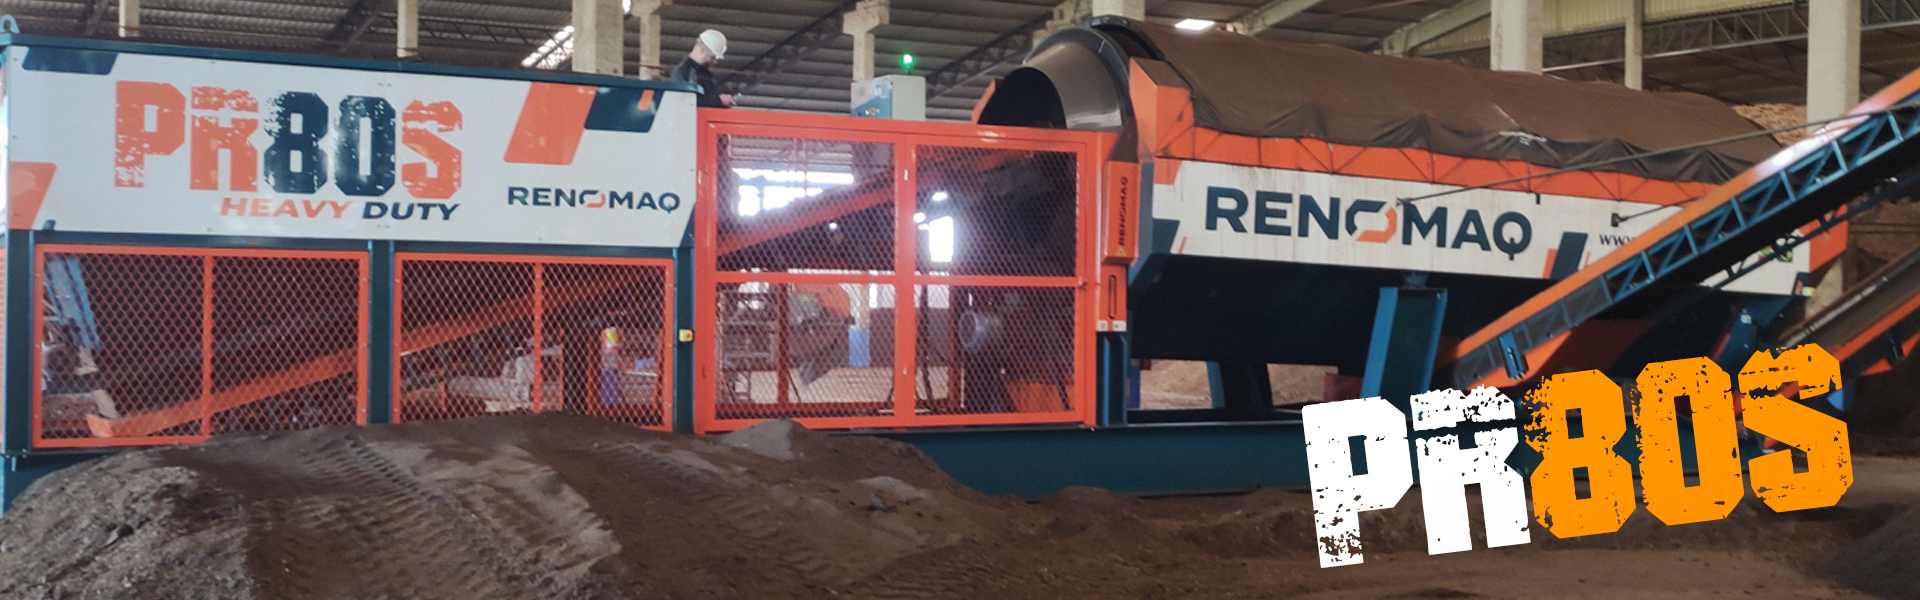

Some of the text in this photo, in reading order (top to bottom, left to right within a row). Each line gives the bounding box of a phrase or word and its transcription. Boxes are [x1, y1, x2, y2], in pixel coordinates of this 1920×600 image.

[114, 80, 464, 199] PR80S
[219, 197, 462, 222] HEAVY DUTY
[507, 186, 681, 213] RENOMAQ
[1118, 176, 1128, 246] RENOMAQ
[1205, 185, 1533, 261] RENOMAQ
